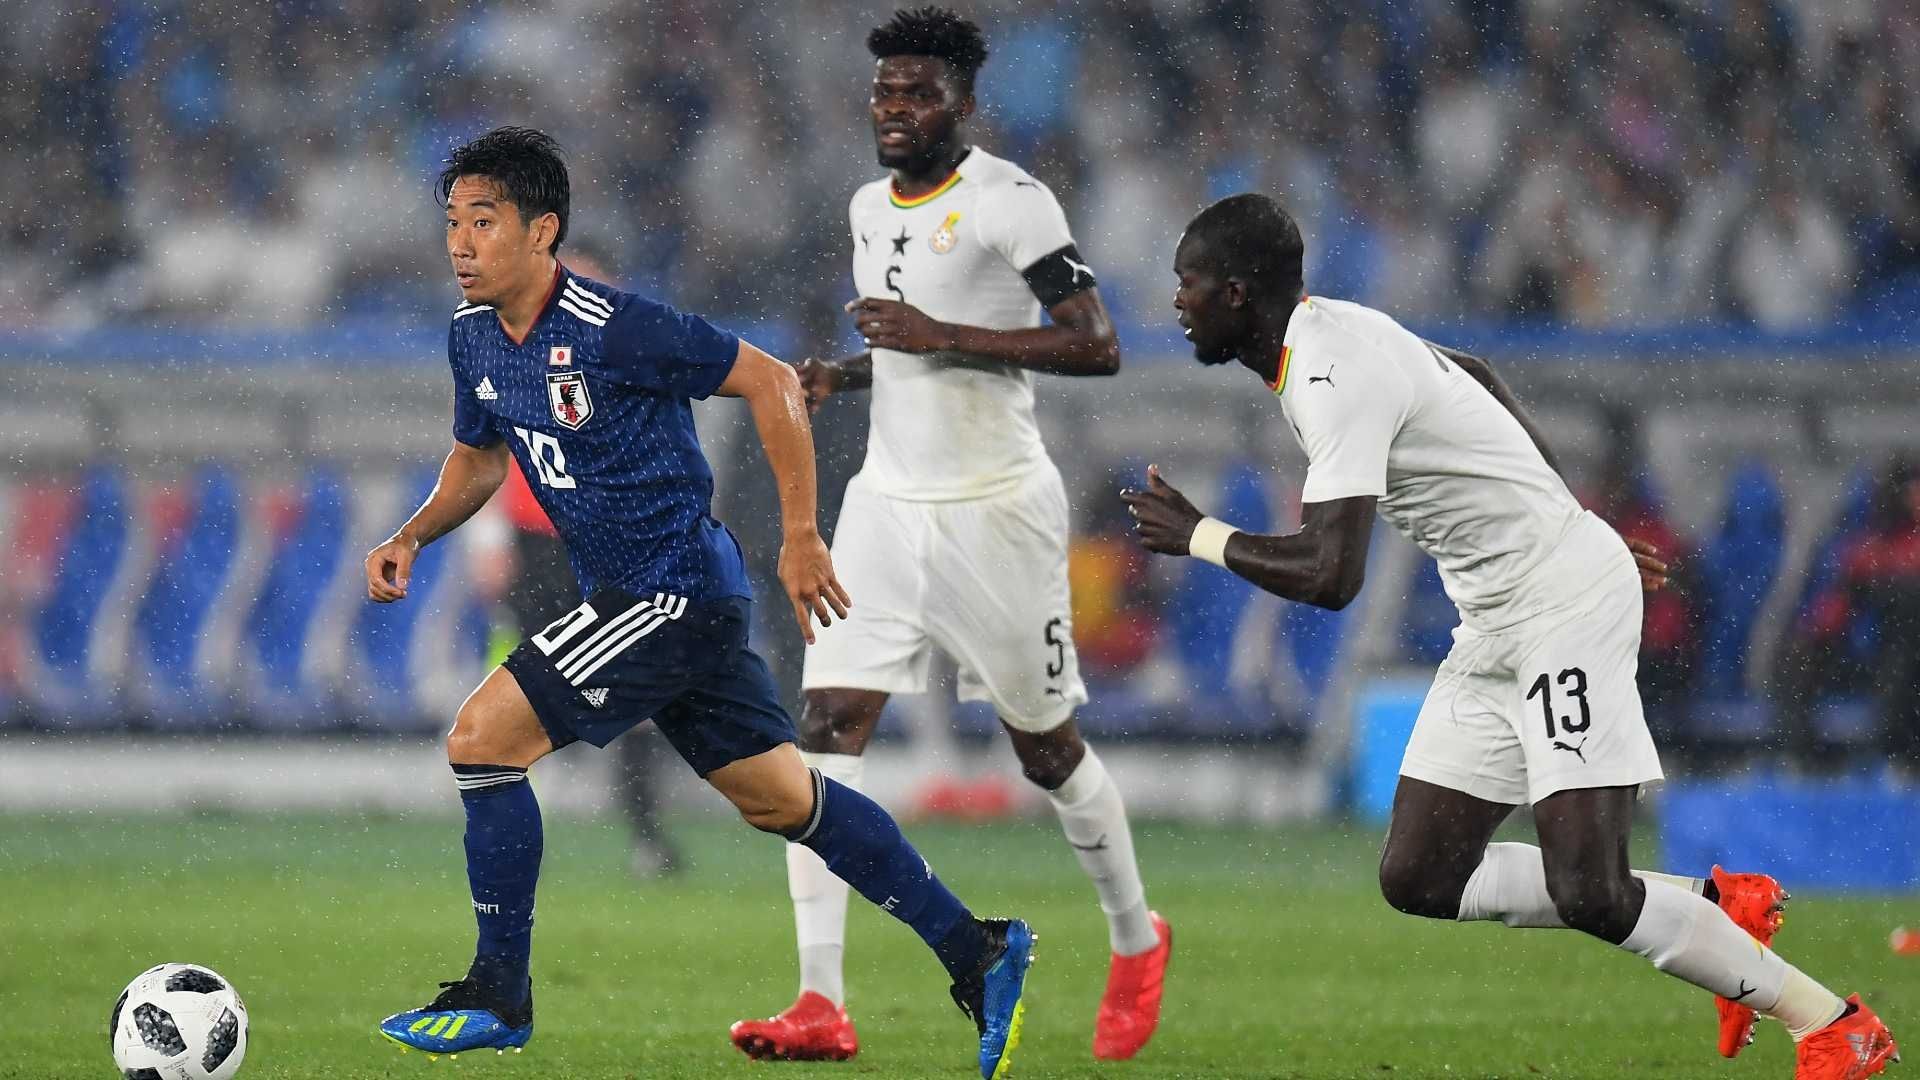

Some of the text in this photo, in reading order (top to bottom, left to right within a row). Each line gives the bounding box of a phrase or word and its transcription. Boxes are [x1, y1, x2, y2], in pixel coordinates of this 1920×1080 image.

[514, 426, 577, 490] 10
[530, 601, 599, 657] 0
[1044, 617, 1063, 679] 5
[1526, 667, 1591, 738] 13
